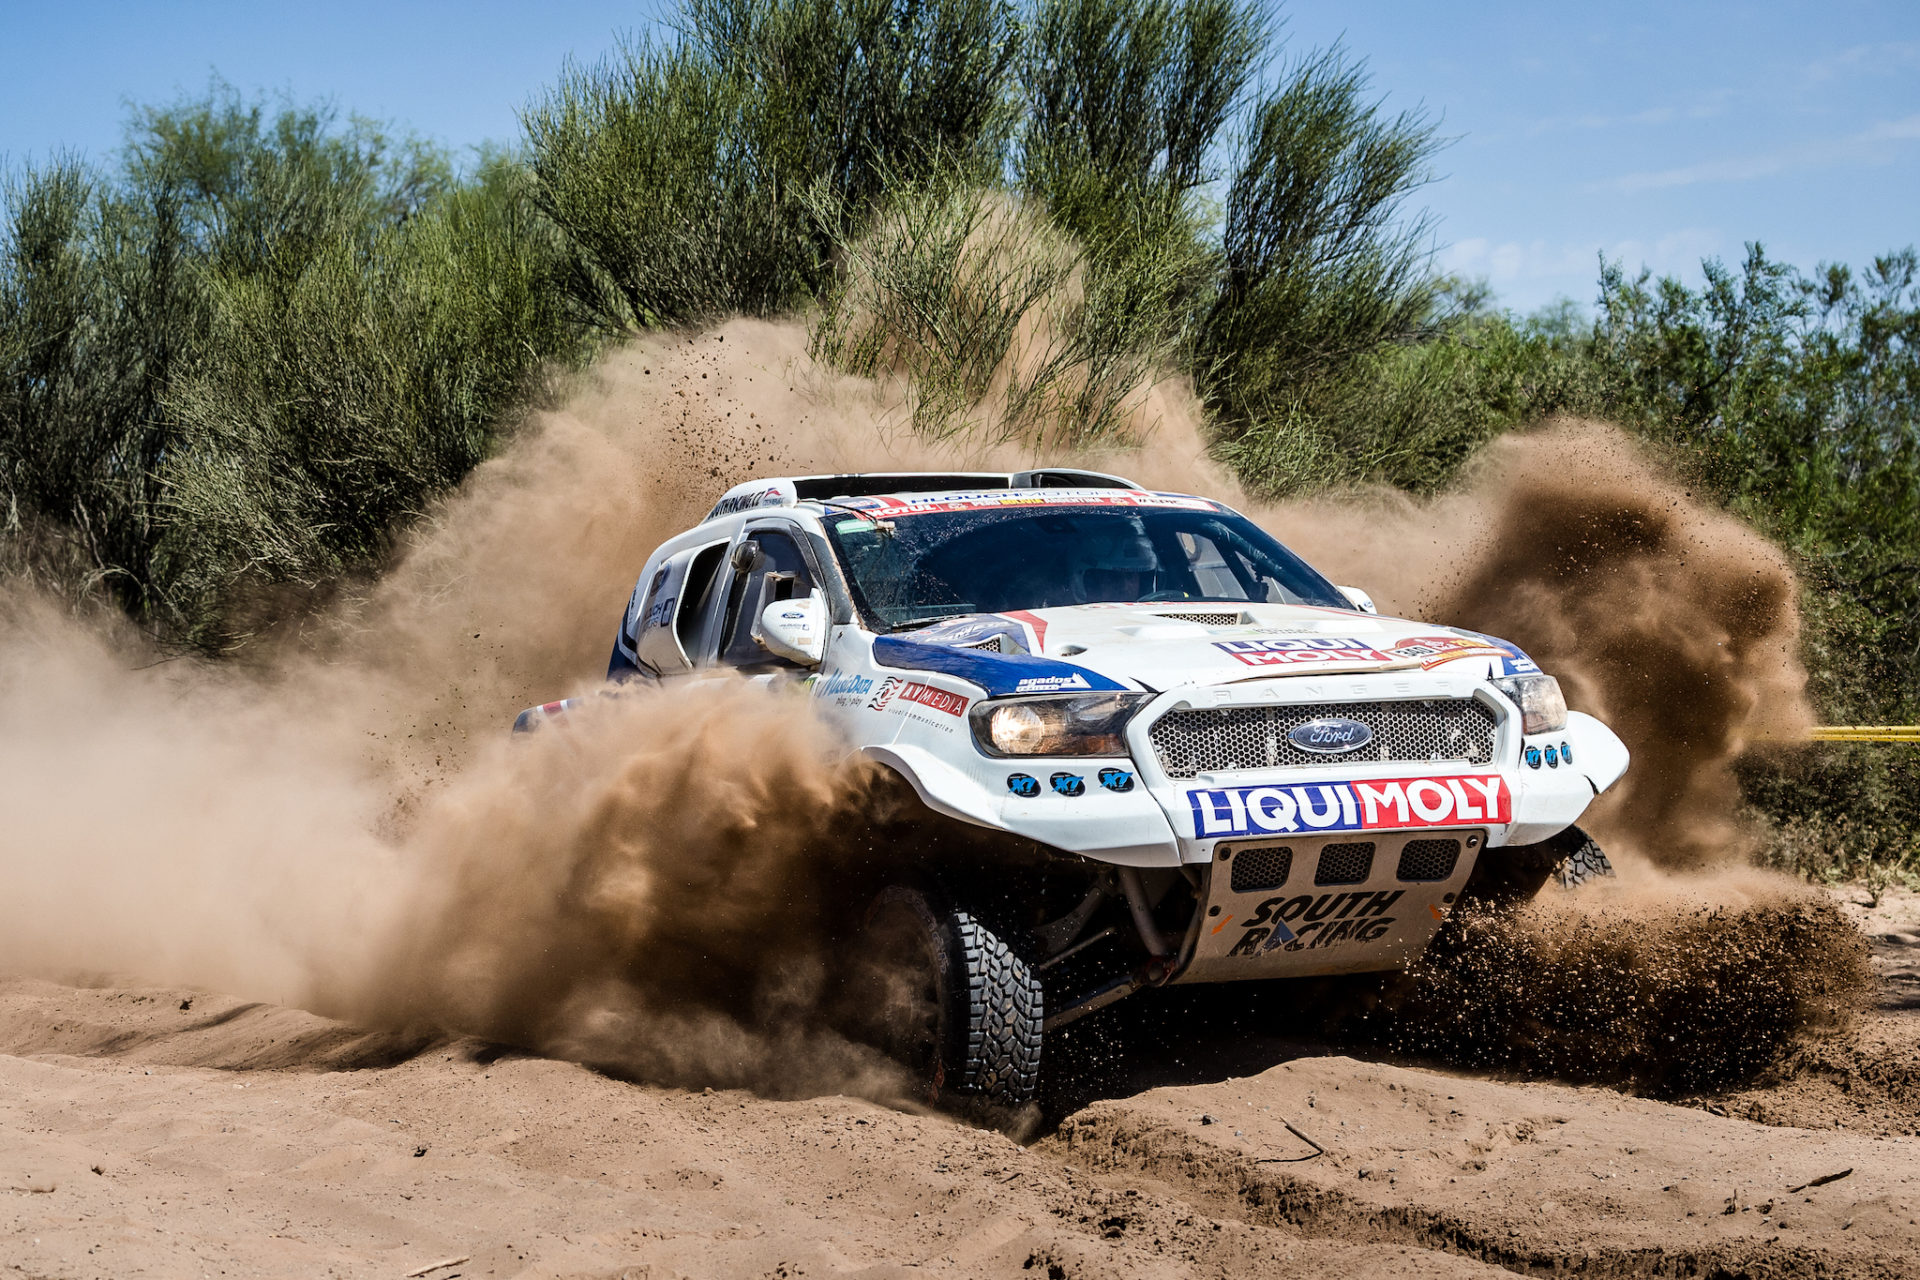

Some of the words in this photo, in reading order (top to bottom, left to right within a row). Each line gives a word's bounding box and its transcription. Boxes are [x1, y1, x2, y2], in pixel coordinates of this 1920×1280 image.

[865, 502, 937, 517] MOTUL
[1219, 638, 1364, 653] LIQUI
[1239, 649, 1382, 665] MOLY
[1018, 676, 1074, 688] agados
[1310, 723, 1355, 743] Ford
[1241, 889, 1406, 927] SOUTH
